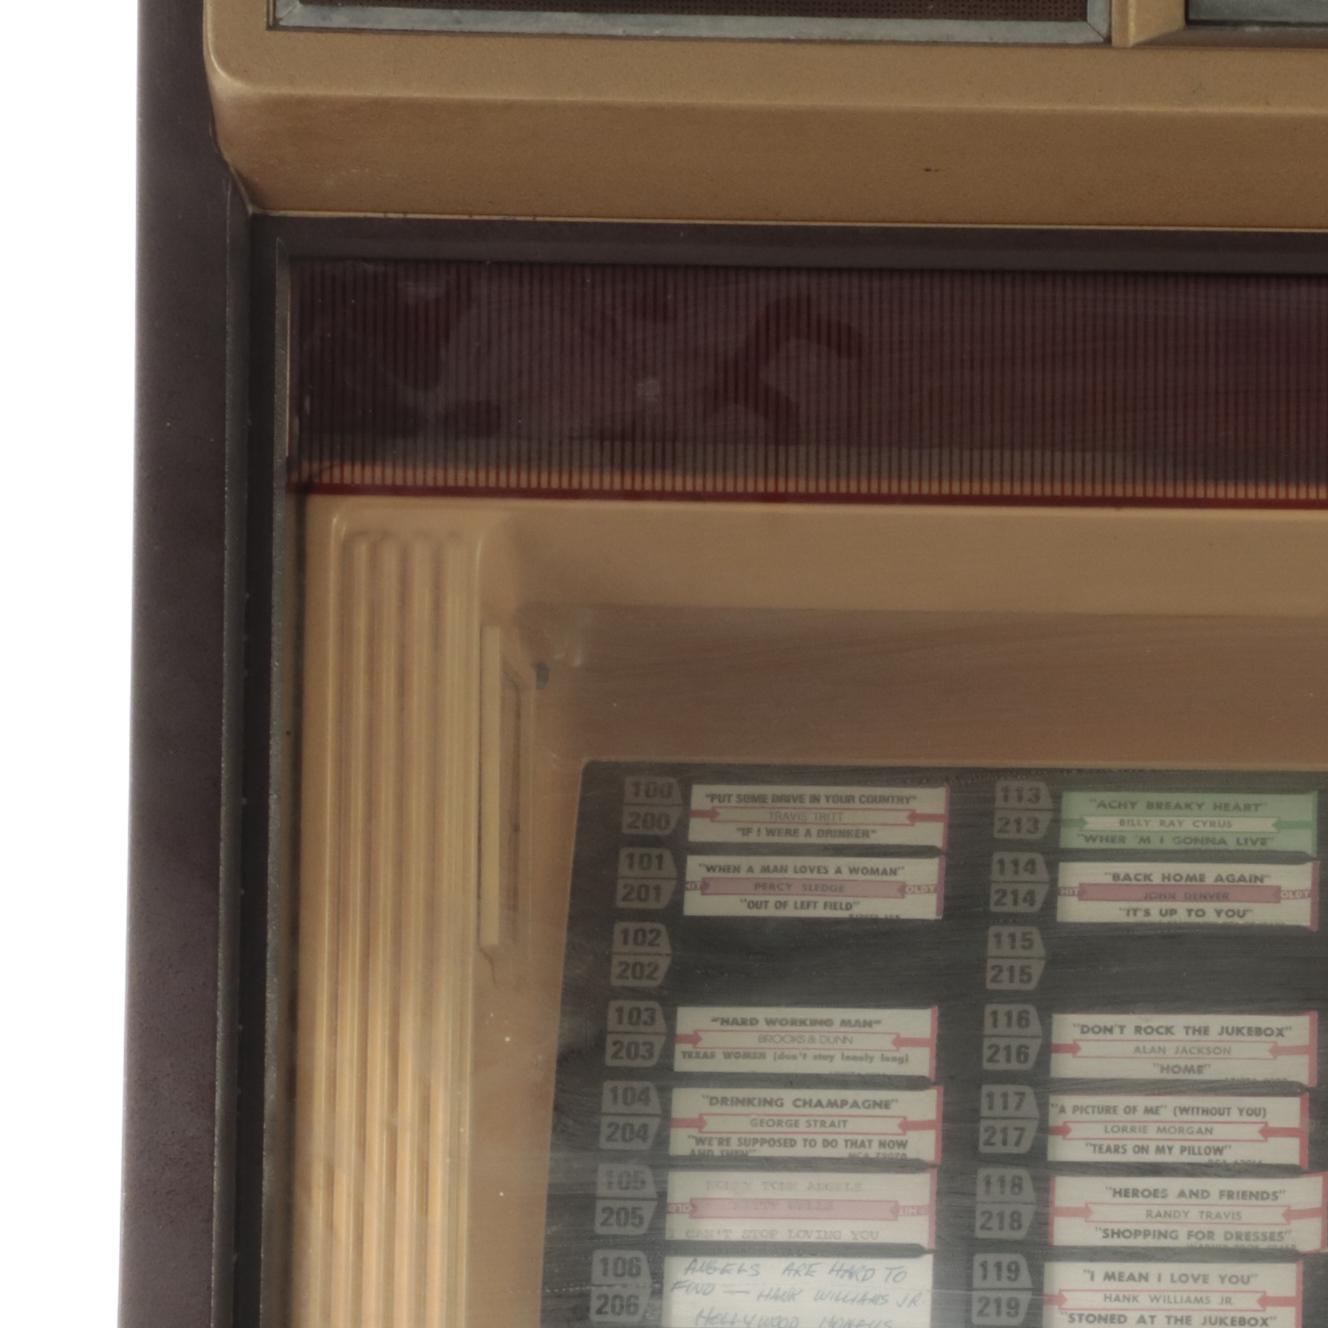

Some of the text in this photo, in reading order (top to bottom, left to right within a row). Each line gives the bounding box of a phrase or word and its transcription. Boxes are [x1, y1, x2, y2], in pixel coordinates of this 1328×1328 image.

[1104, 872, 1271, 884] "BACK HOME AGAIN"
[619, 928, 661, 946] 102
[615, 961, 659, 979] 202
[702, 1095, 899, 1110] "DRINKING CHAMPAGNE"
[750, 1118, 848, 1129] GEORGE STRAIT
[983, 1127, 1026, 1146] 217
[1105, 1186, 1286, 1202] "HEROES AND FRIENDS"
